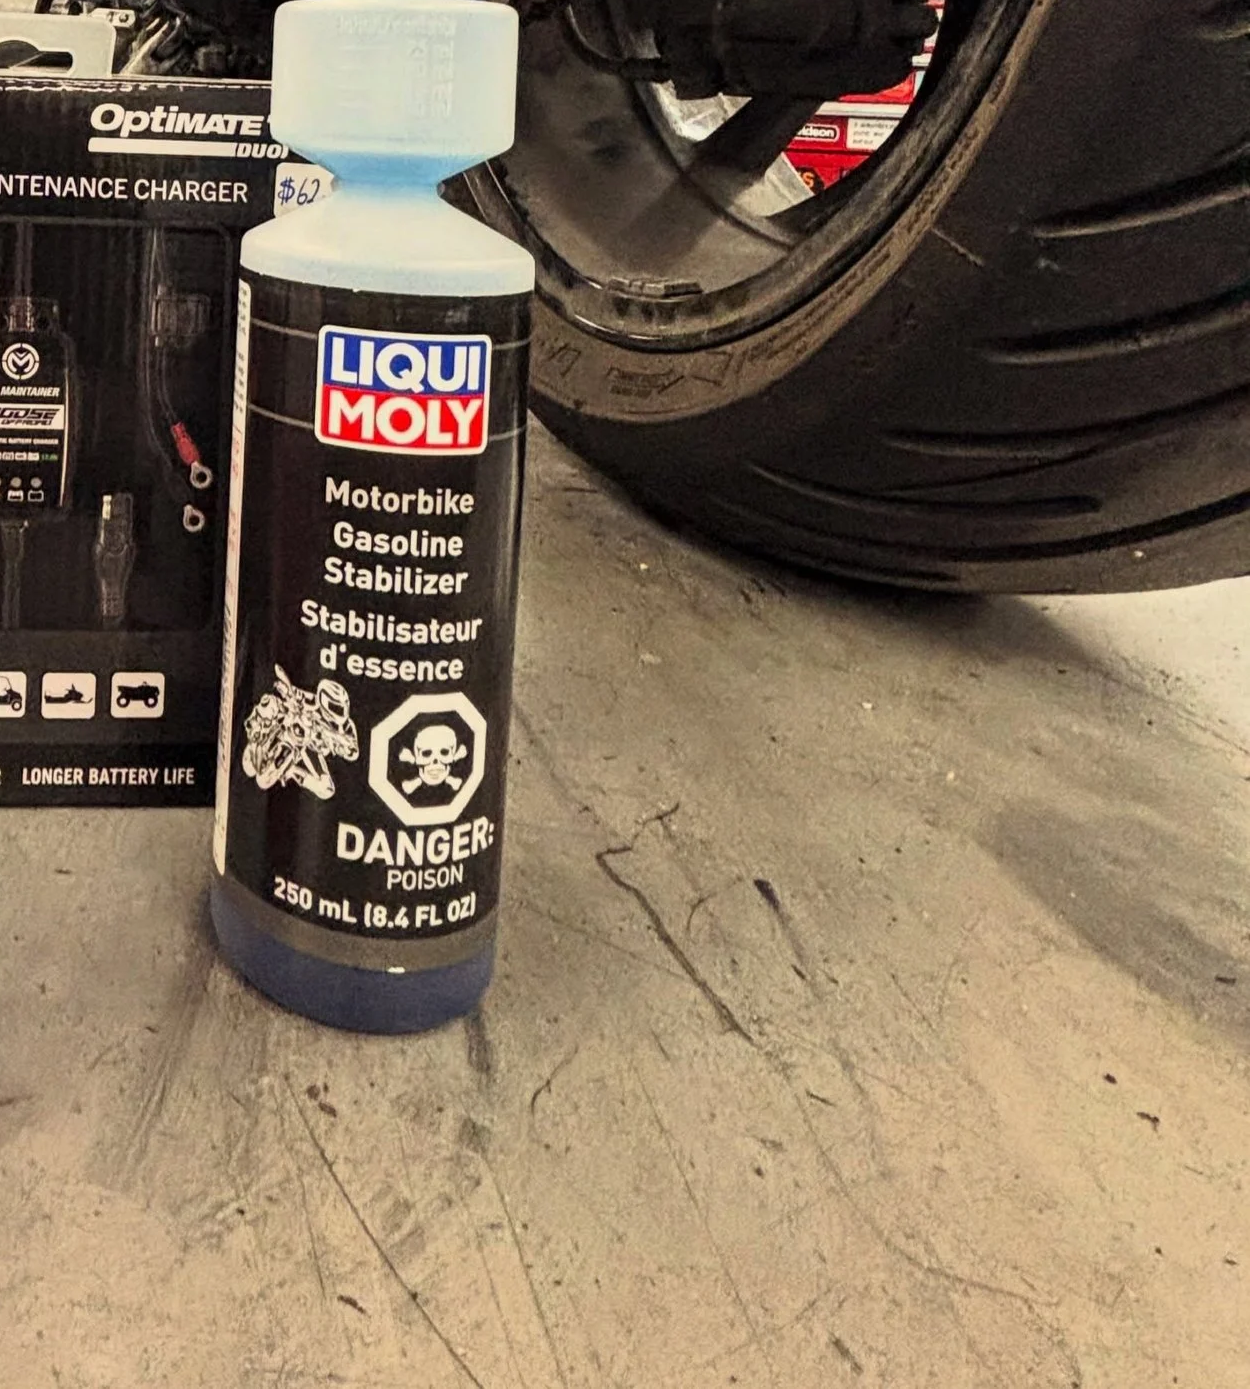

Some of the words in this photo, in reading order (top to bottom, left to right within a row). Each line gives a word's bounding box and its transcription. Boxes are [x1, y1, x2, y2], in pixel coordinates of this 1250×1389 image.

[134, 179, 248, 203] CHARGER
[330, 336, 481, 393] LIQUI
[0, 386, 60, 397] MAINTAINER
[328, 389, 483, 446] MOLY
[325, 477, 475, 516] Motorbike
[333, 522, 463, 558] Gasoline
[324, 558, 468, 597] Stabilizer
[301, 600, 482, 645] Stabilisateur
[320, 644, 463, 682] d'essence
[22, 768, 83, 785] LONGER
[88, 768, 159, 785] BATTERY
[163, 768, 195, 785] LIFE
[386, 863, 464, 891] POISON
[273, 876, 313, 910] 250
[318, 898, 357, 924] mL
[364, 902, 409, 928] (8.4
[415, 905, 442, 928] FL
[447, 892, 476, 922] OZ)
